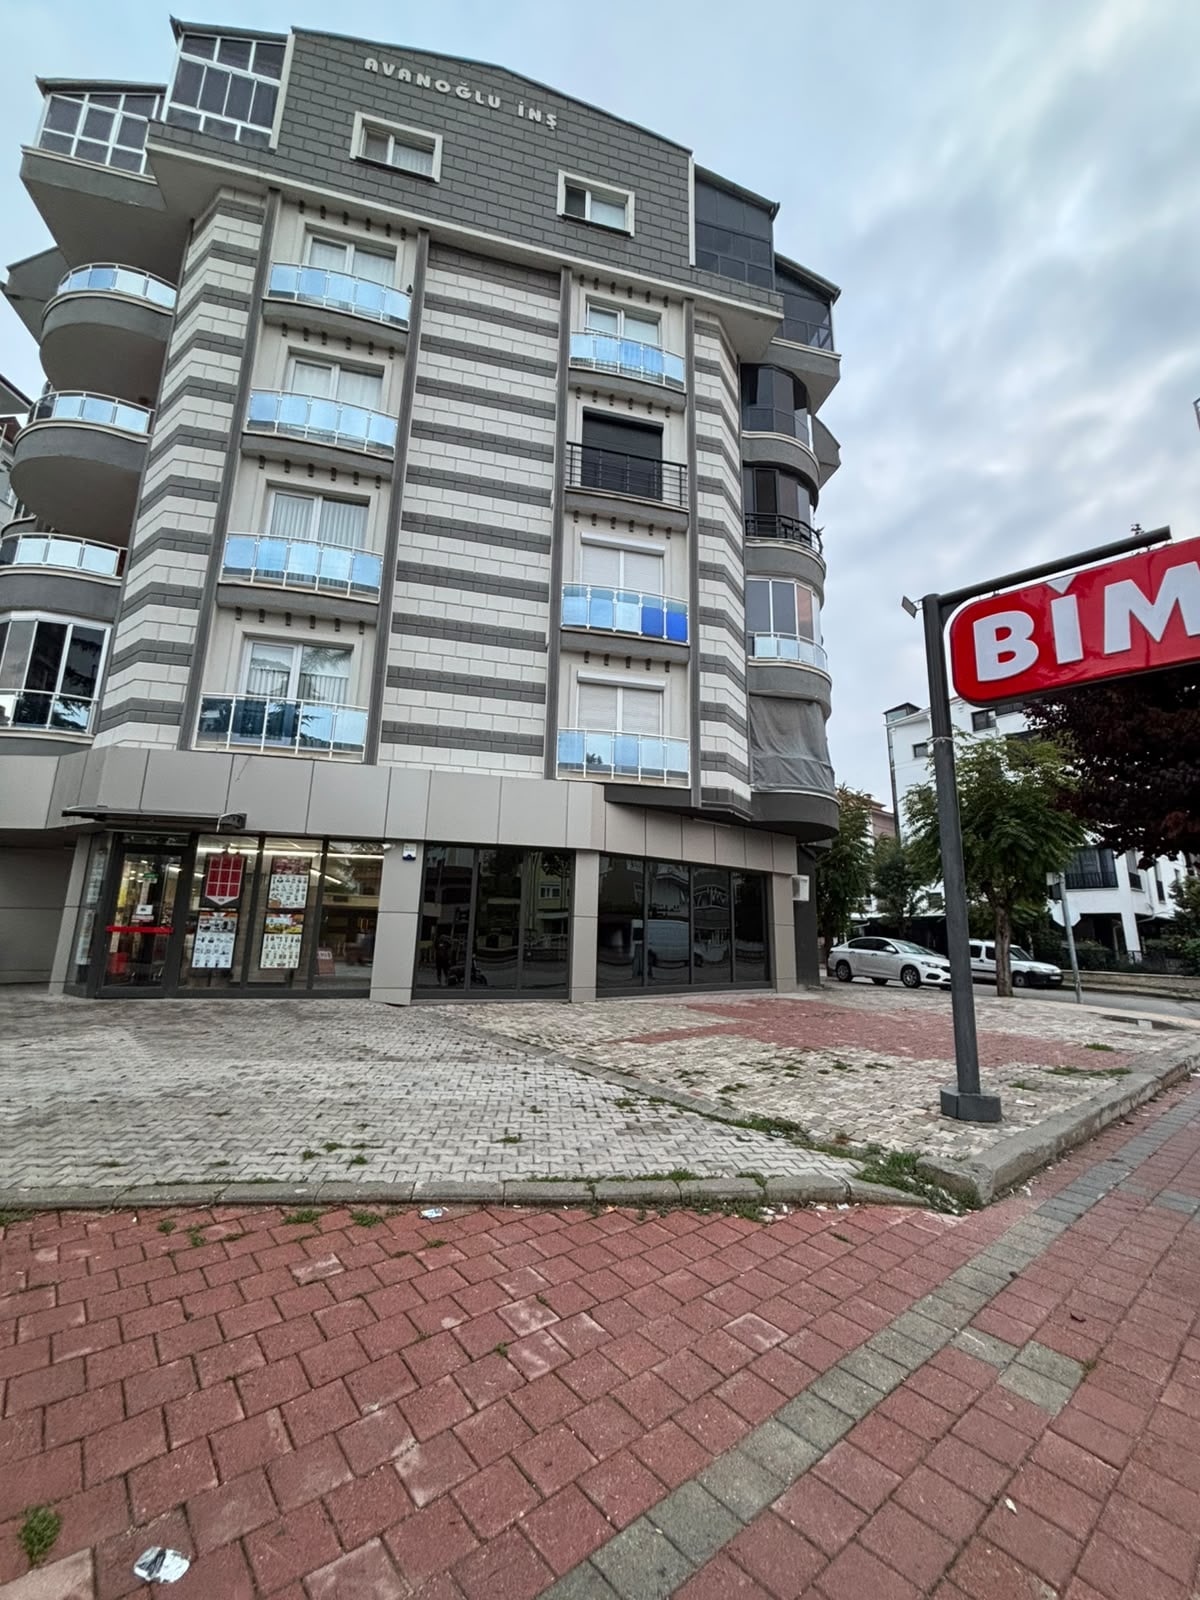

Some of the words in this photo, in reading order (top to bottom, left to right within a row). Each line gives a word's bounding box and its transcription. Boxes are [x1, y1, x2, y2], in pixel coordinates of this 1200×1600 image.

[364, 57, 502, 109] AVANOĞLU
[517, 101, 558, 131] İNŞ
[973, 561, 1200, 682] BİM
